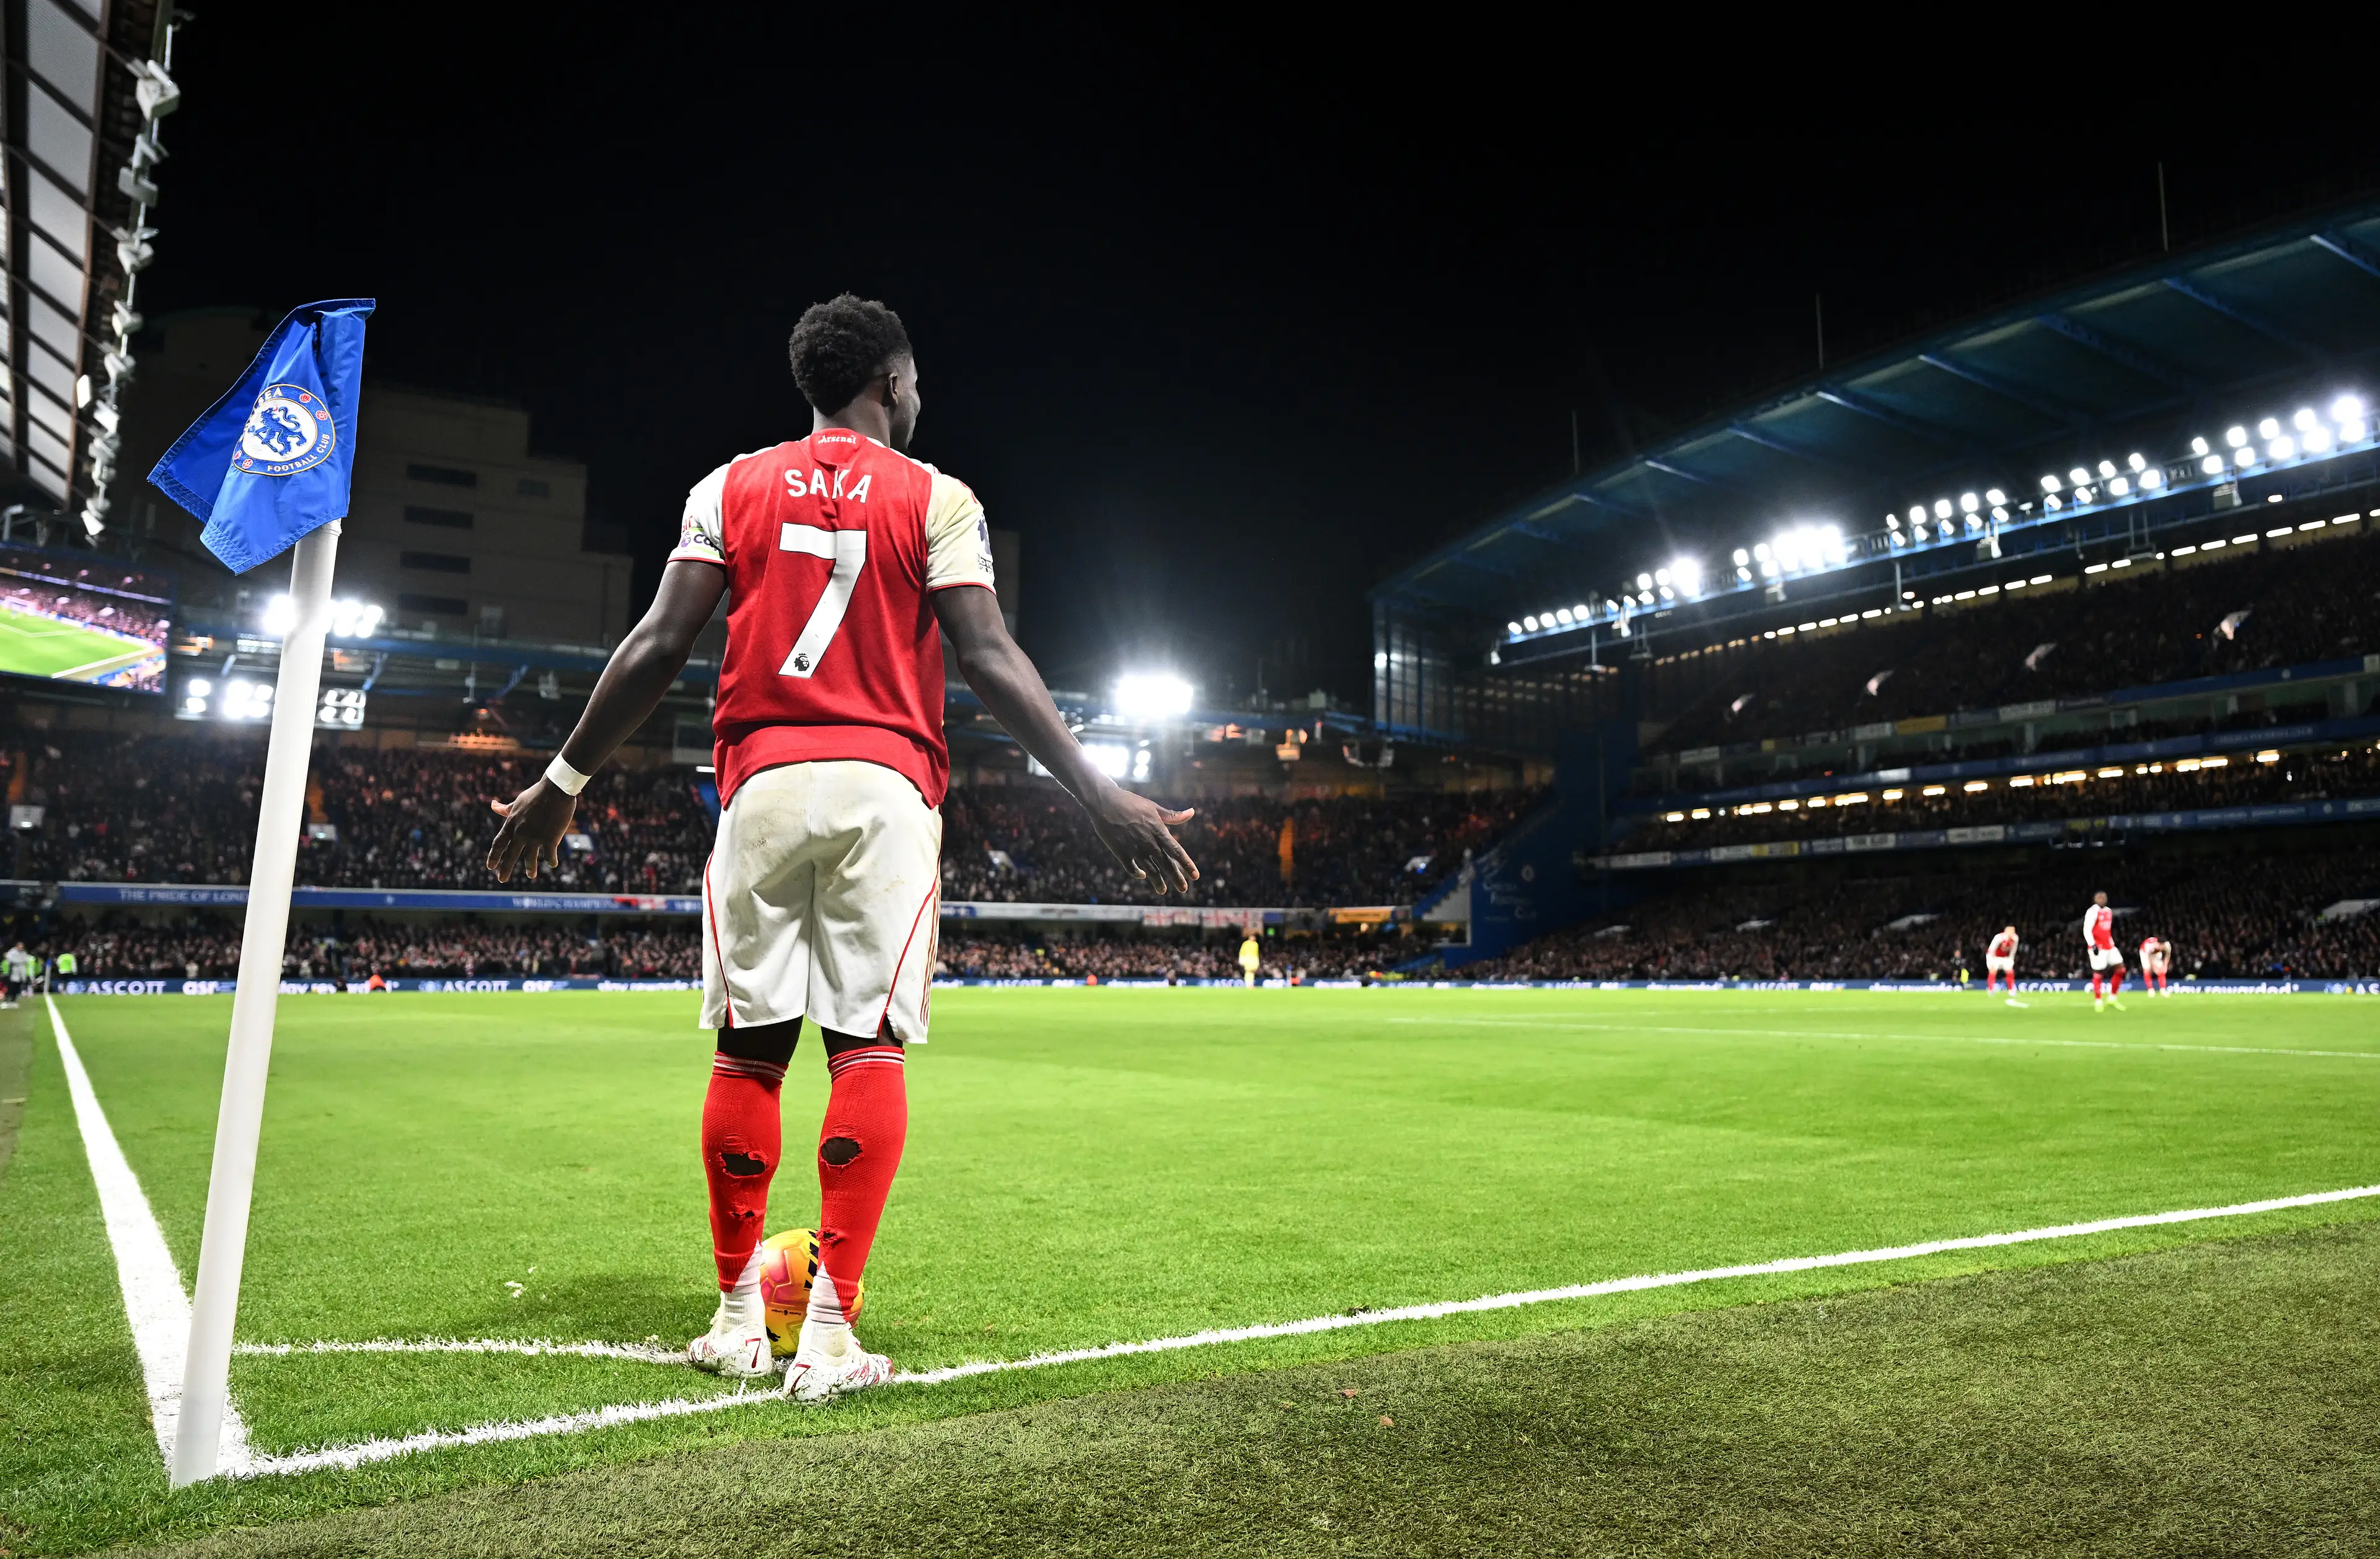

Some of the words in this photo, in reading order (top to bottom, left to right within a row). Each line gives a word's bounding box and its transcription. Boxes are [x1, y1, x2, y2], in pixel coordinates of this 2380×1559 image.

[267, 454, 318, 472] FOOTBALL
[316, 433, 331, 453] CLUB
[818, 435, 857, 444] Arsenal
[784, 468, 872, 504] SAKA
[777, 522, 867, 679] 7
[87, 980, 166, 995] ASCOTT
[443, 980, 510, 993] ASCOTT
[746, 1338, 761, 1369] 7
[790, 1363, 811, 1395] 7
